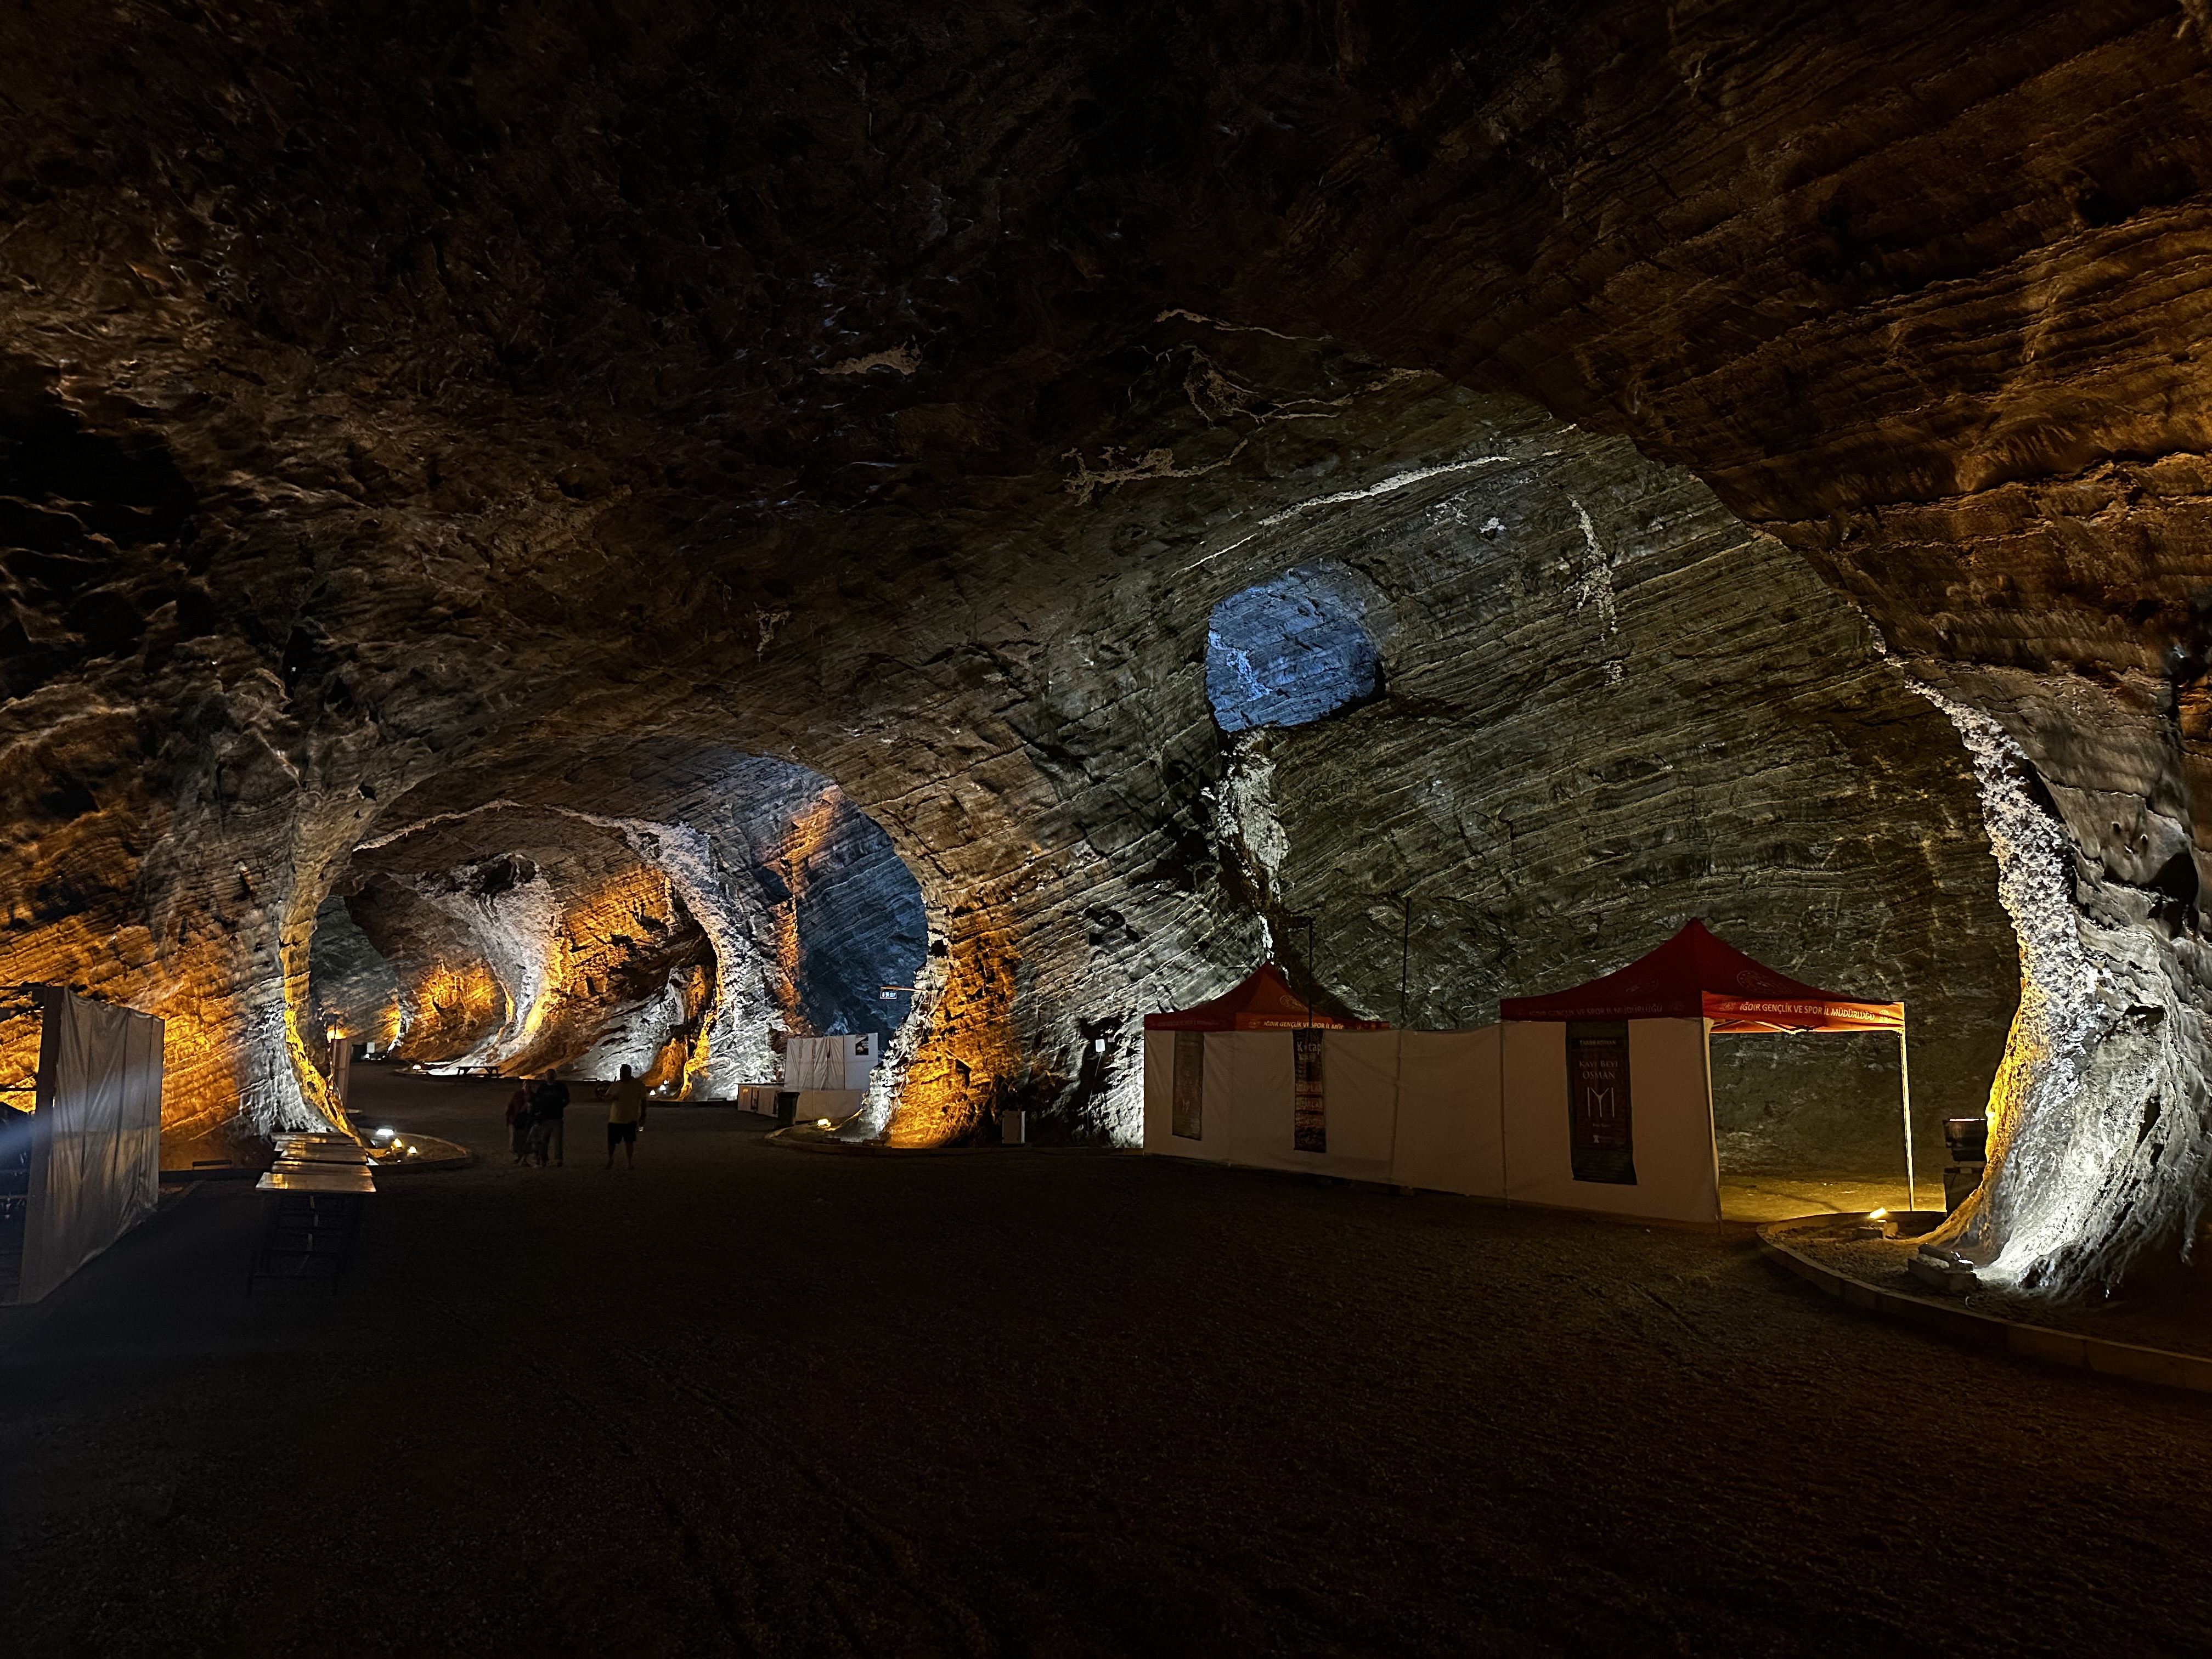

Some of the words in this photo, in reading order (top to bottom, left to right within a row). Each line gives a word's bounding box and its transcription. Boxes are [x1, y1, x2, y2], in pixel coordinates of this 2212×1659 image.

[1740, 1001, 1761, 1011] IĞDIR
[1762, 1003, 1792, 1014] GENÇLİK
[1793, 1005, 1803, 1013] VE
[1804, 1005, 1823, 1014] SPOR
[1831, 1007, 1875, 1021] MÜDÜRLÜĞÜ
[1582, 1070, 1615, 1080] OSMAN
